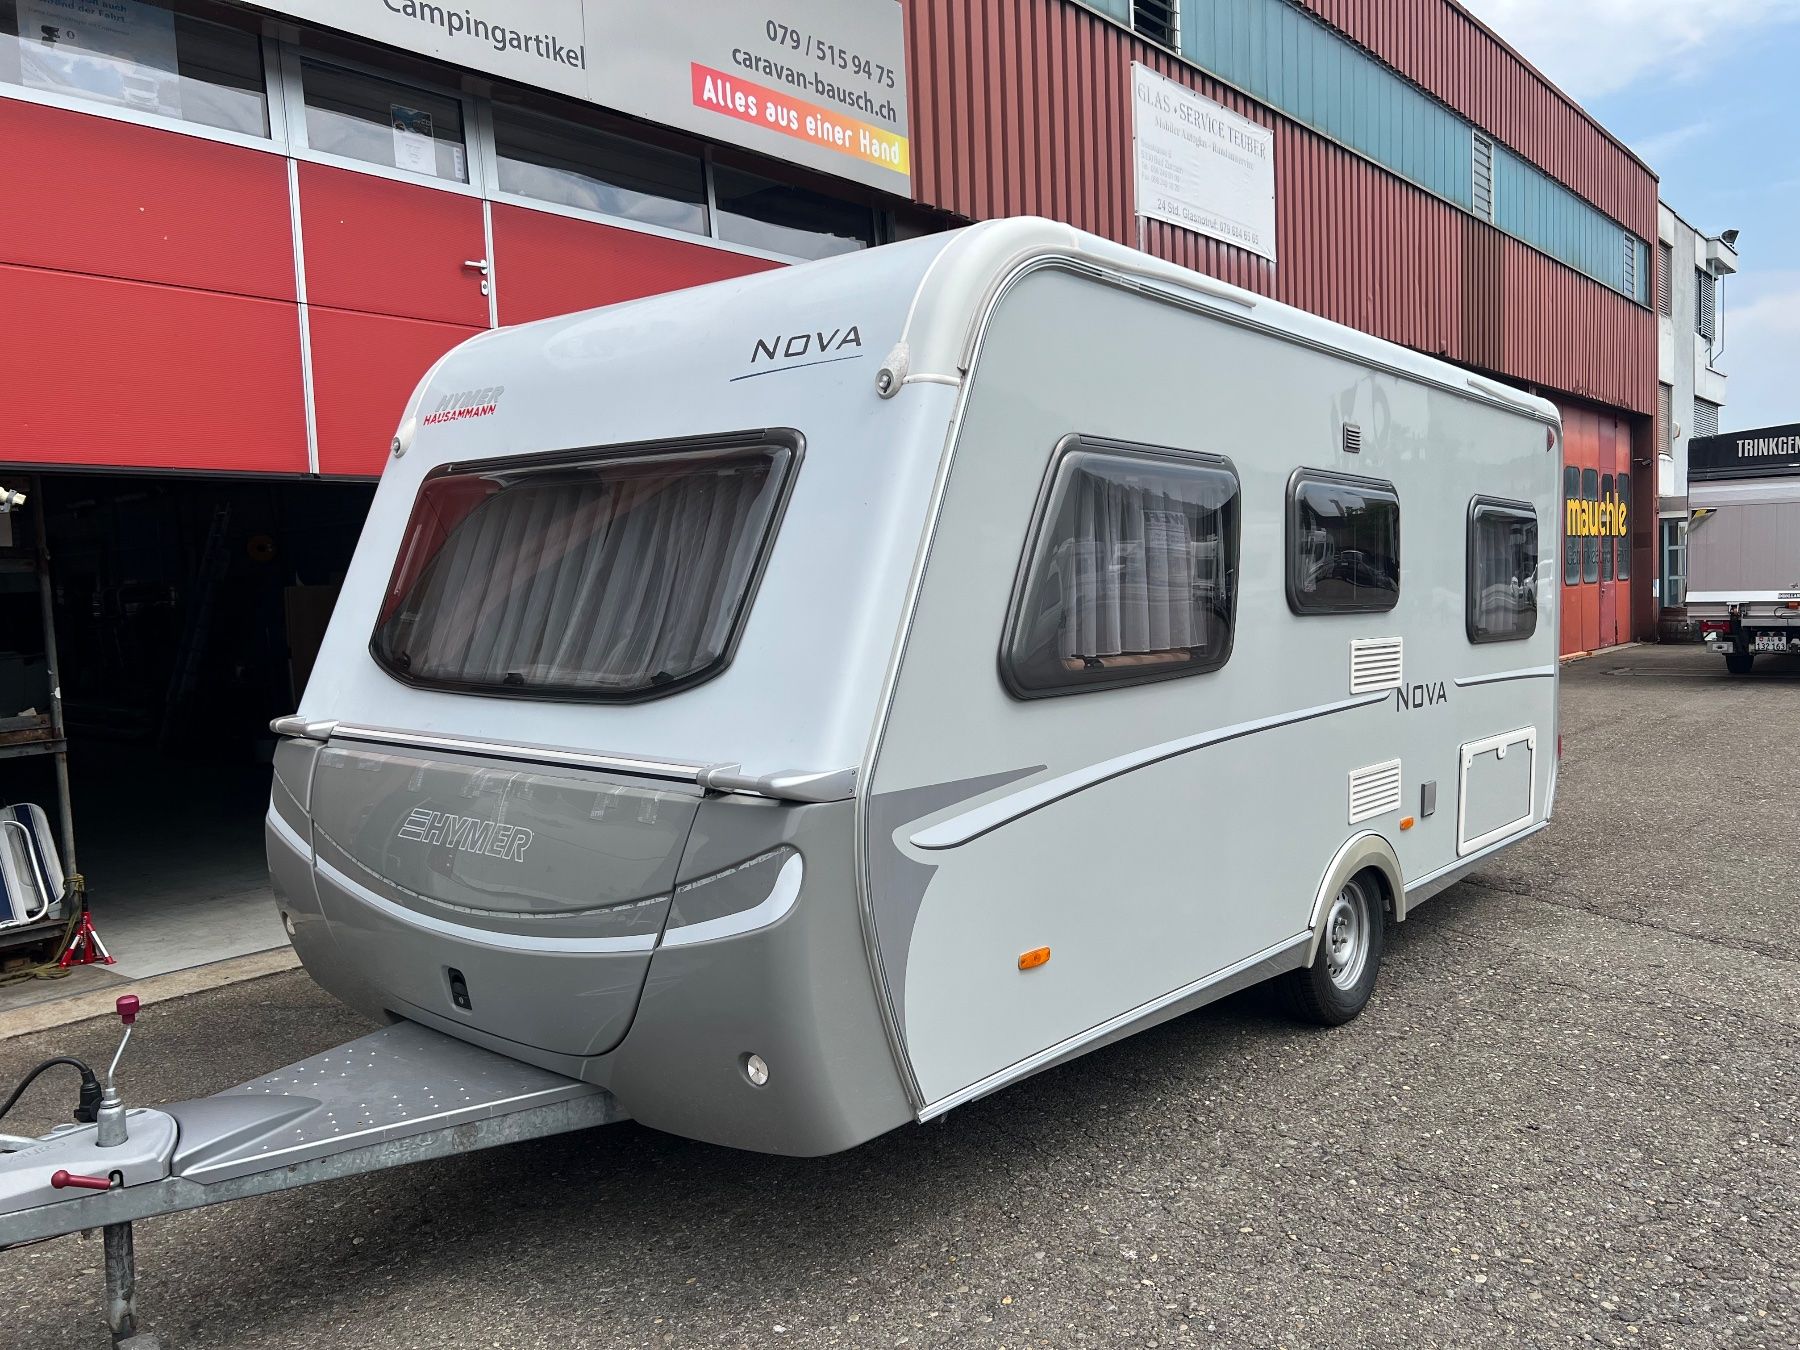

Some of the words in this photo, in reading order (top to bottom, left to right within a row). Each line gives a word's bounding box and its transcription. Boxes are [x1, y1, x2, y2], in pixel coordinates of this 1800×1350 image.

[766, 20, 801, 50] 079
[806, 35, 812, 56] /
[816, 40, 848, 69] 515
[851, 55, 873, 80] 94
[875, 64, 895, 88] 75
[732, 48, 897, 123] caravan-bausch.ch
[703, 75, 758, 117] Alles
[765, 101, 799, 131] aus
[805, 113, 853, 148] einer
[859, 128, 900, 164] Hand
[1138, 82, 1171, 113] GLAS
[1179, 102, 1225, 140] SERVICE
[1227, 126, 1266, 160] TEUBER
[1157, 198, 1166, 211] 24
[751, 326, 862, 363] NOVA
[423, 404, 497, 426] HAUSAMMANN
[435, 385, 505, 412] HYMER
[1566, 491, 1627, 537] mauchle
[1396, 681, 1447, 712] NOVA
[422, 811, 534, 863] HYMER
